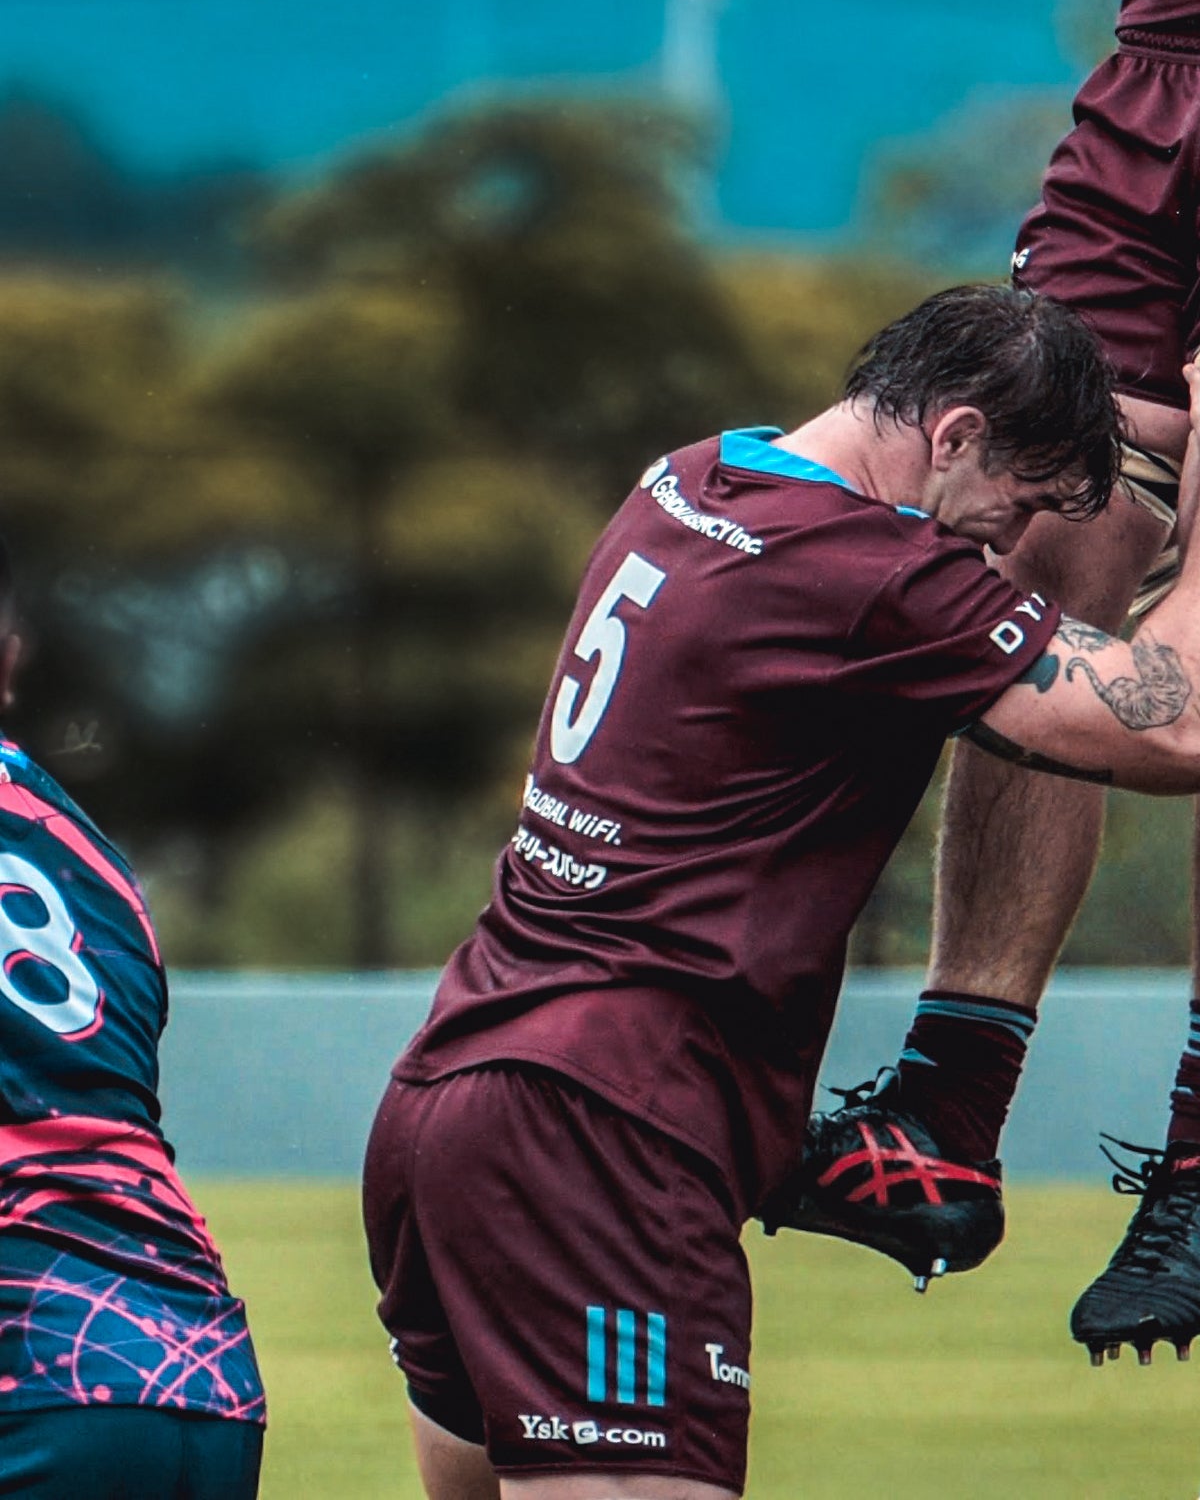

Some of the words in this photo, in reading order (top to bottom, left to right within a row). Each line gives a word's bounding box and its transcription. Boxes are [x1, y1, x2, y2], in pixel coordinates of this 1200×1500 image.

[550, 552, 666, 764] 5
[0, 852, 98, 1033] 8
[518, 1414, 570, 1441] Ysk
